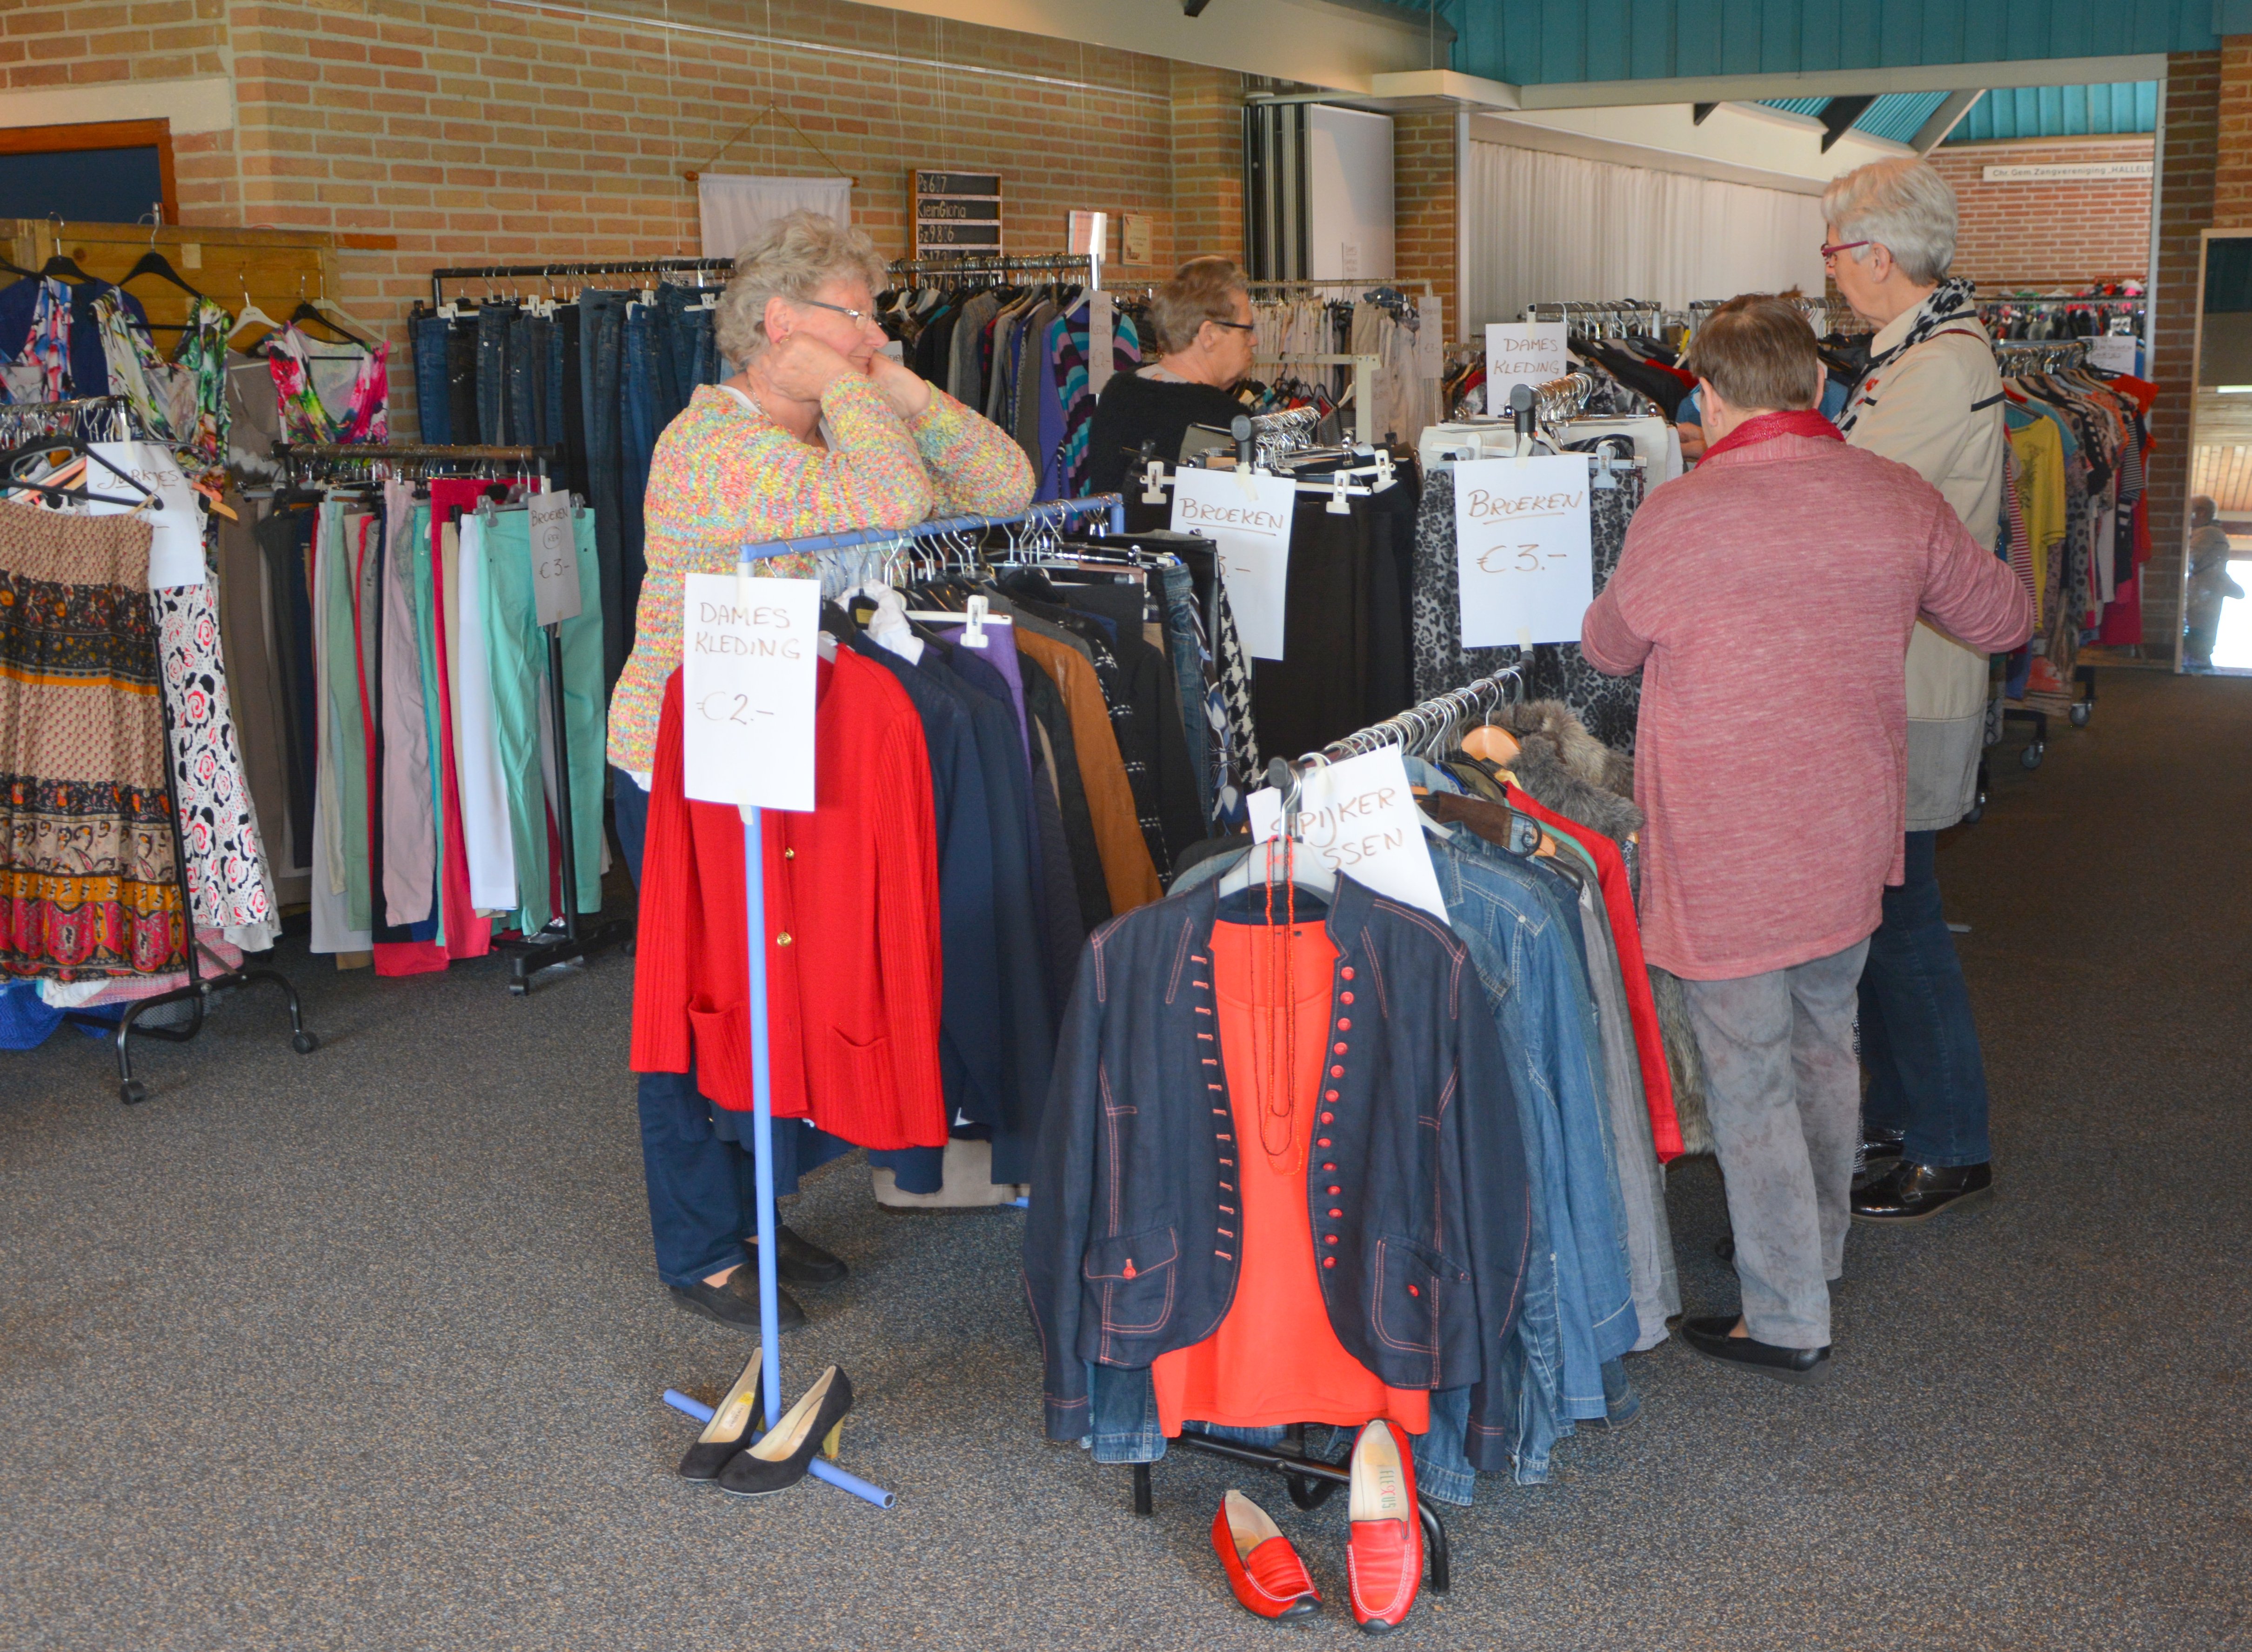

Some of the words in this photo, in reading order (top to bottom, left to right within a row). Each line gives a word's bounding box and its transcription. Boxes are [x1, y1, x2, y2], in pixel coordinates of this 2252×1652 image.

[1504, 338, 1558, 352] DAMES
[1493, 360, 1559, 375] KLEDING
[531, 506, 568, 527] BROEKEN
[1179, 497, 1283, 529] BROEKEN
[1468, 489, 1583, 518] BROEKEN
[700, 602, 790, 629] DAMES
[695, 631, 801, 660] KLEDING
